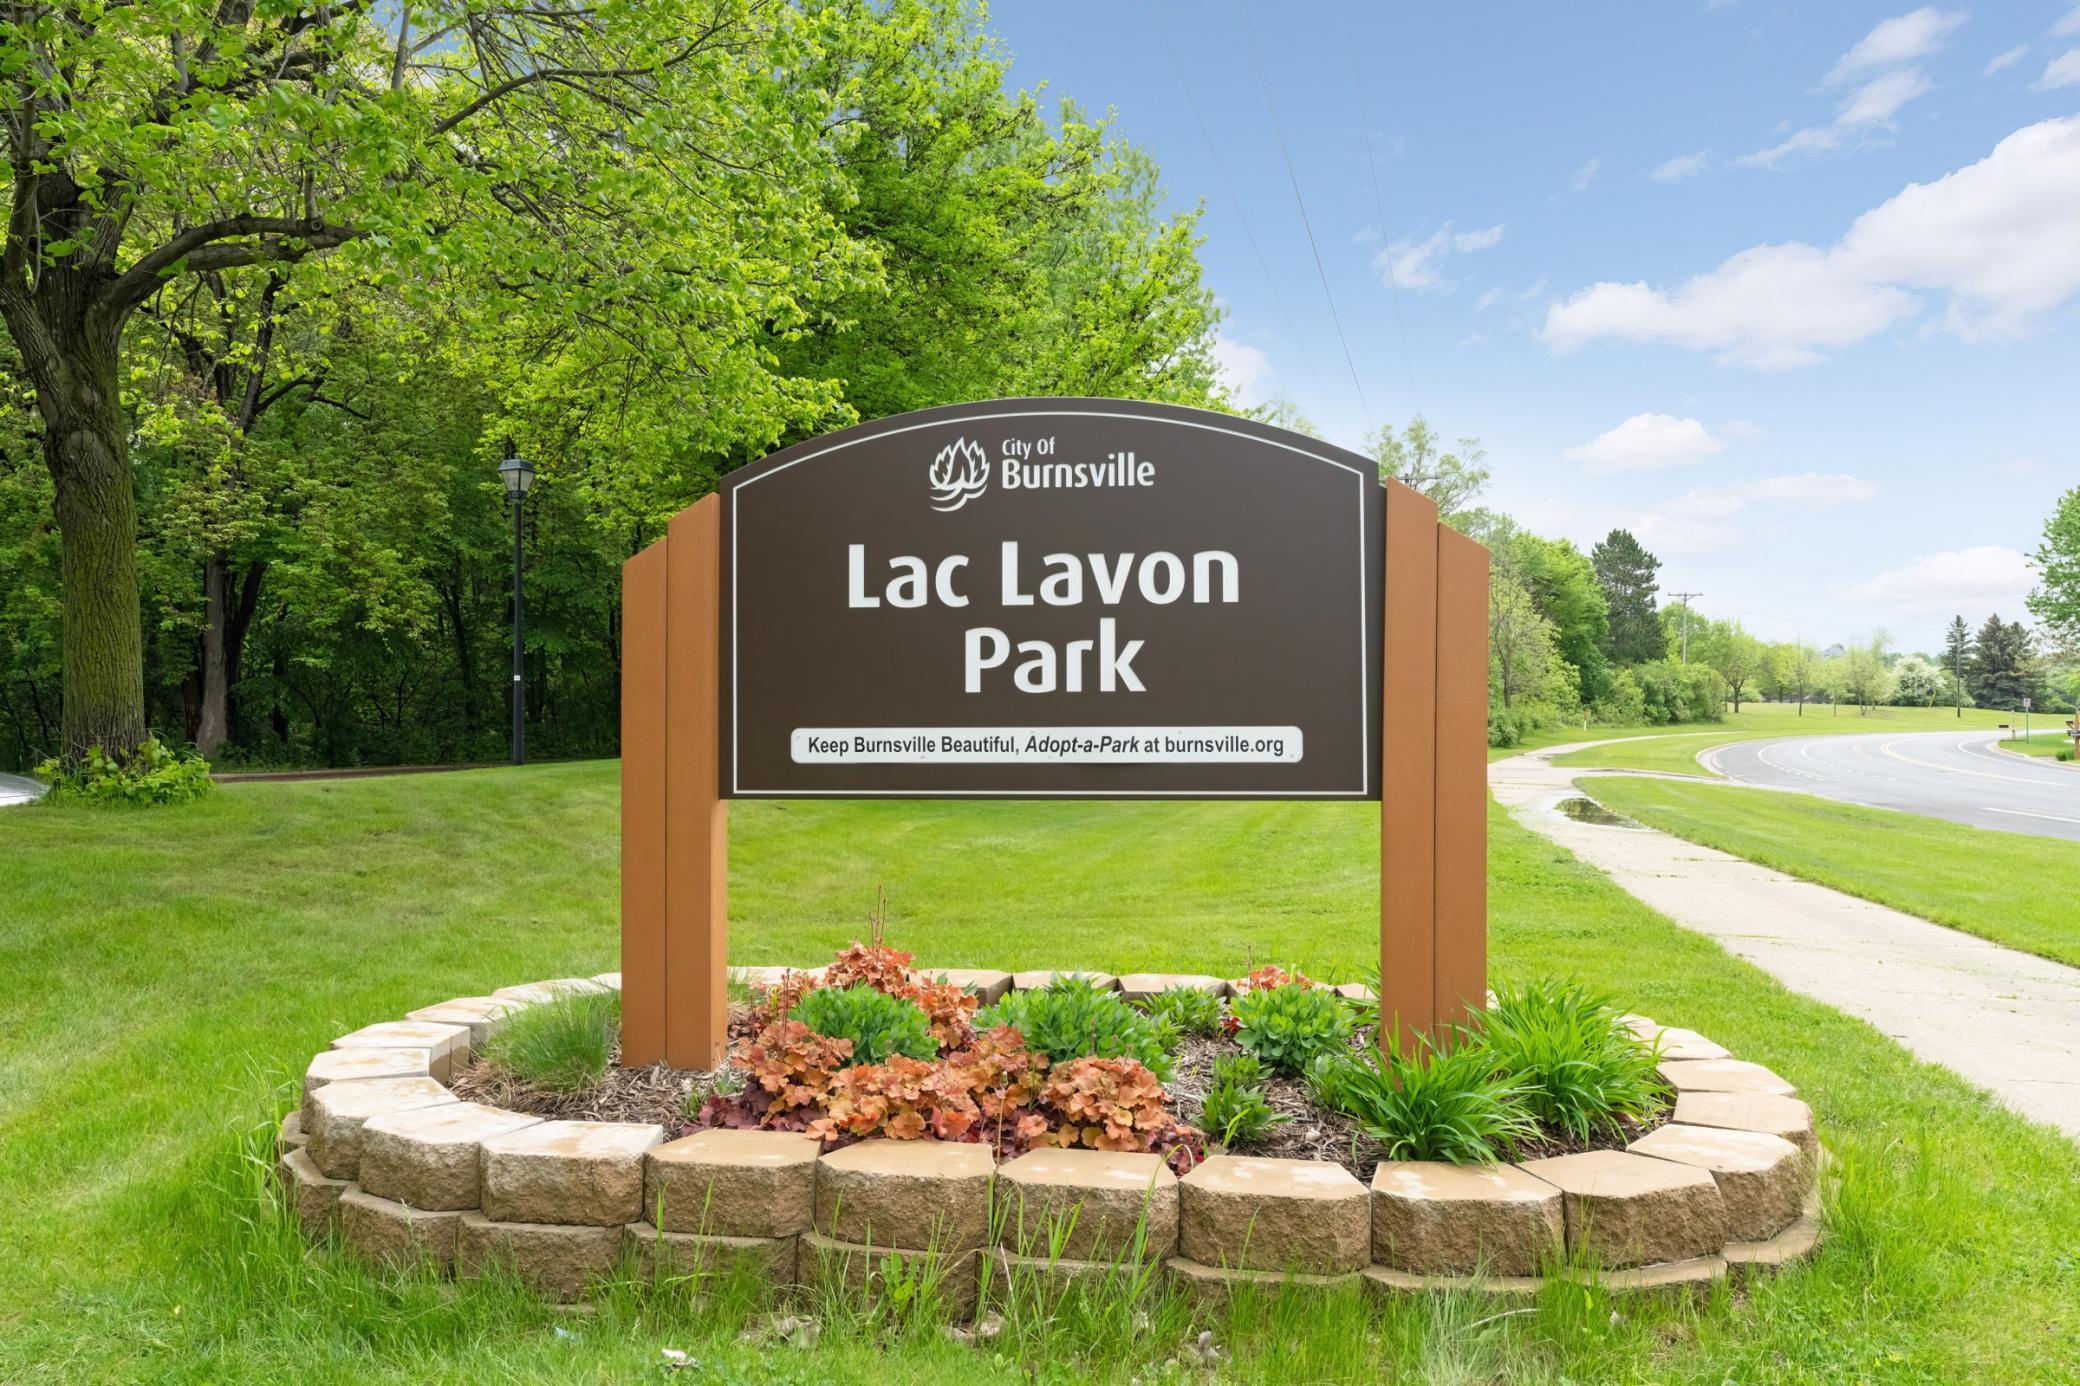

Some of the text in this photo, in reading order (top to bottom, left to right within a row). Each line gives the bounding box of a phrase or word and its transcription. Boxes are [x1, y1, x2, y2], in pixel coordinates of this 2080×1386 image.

[1002, 437, 1056, 460] City Of
[1001, 452, 1156, 490] Burnsville
[848, 540, 1240, 609] Lac Lavon
[964, 617, 1147, 694] Park
[808, 735, 1284, 757] Keep Burnsville Beautiful, Adopt-a-Park at burnsville.org
